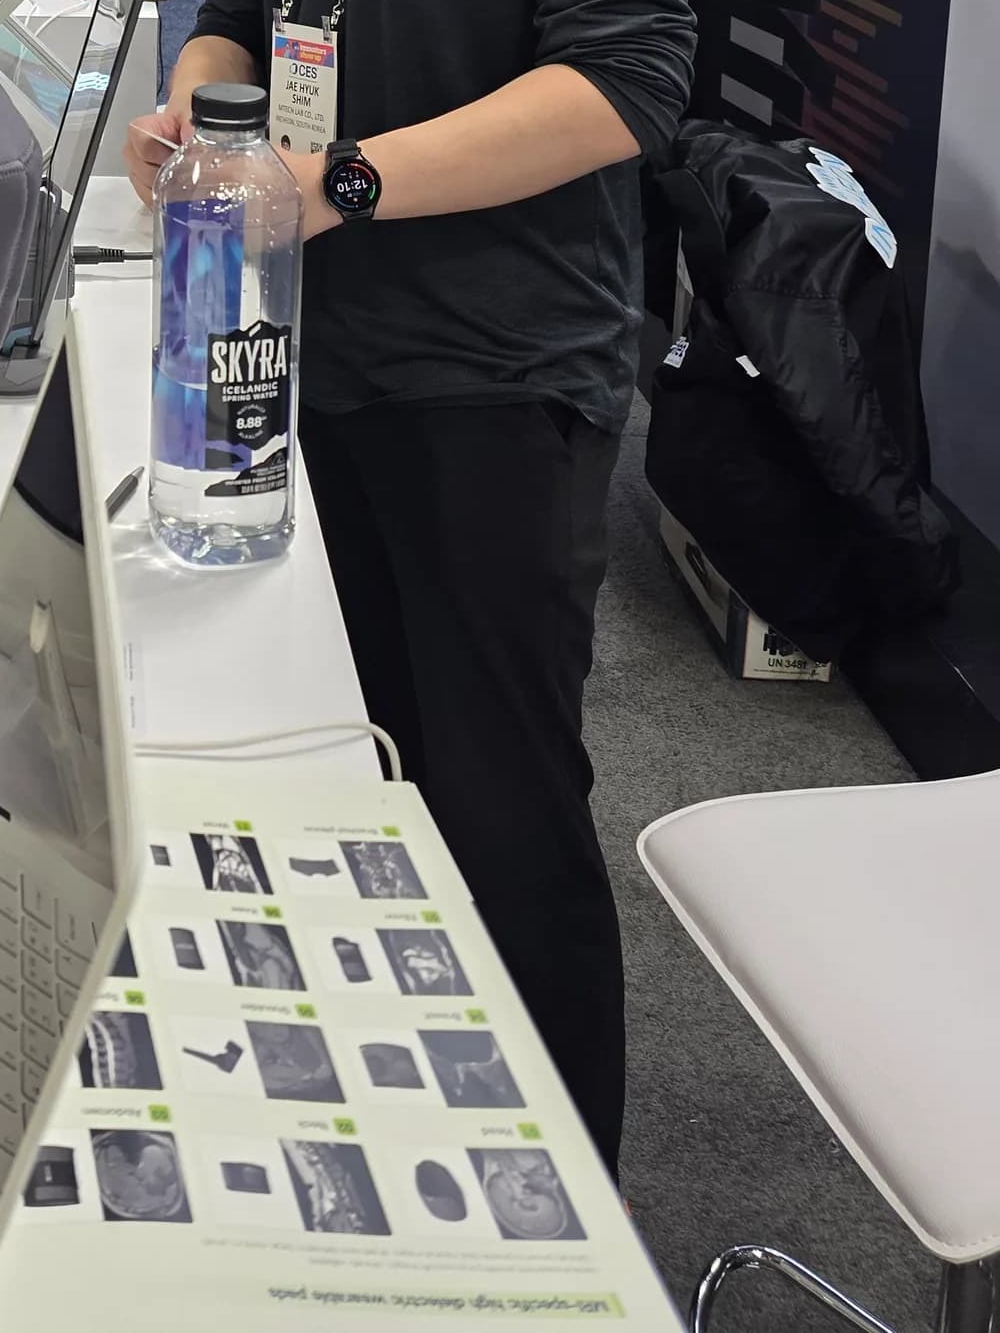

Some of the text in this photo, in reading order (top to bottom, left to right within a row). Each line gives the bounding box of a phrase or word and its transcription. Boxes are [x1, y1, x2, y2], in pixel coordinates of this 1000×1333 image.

[299, 64, 318, 79] CES
[286, 80, 320, 97] JAE HYUK
[292, 93, 311, 107] SHIM
[337, 179, 368, 193] 12:10
[211, 336, 288, 384] SKYRA
[222, 382, 278, 395] ICELANDIC
[222, 390, 278, 403] SPRING WATER
[768, 657, 783, 667] UN
